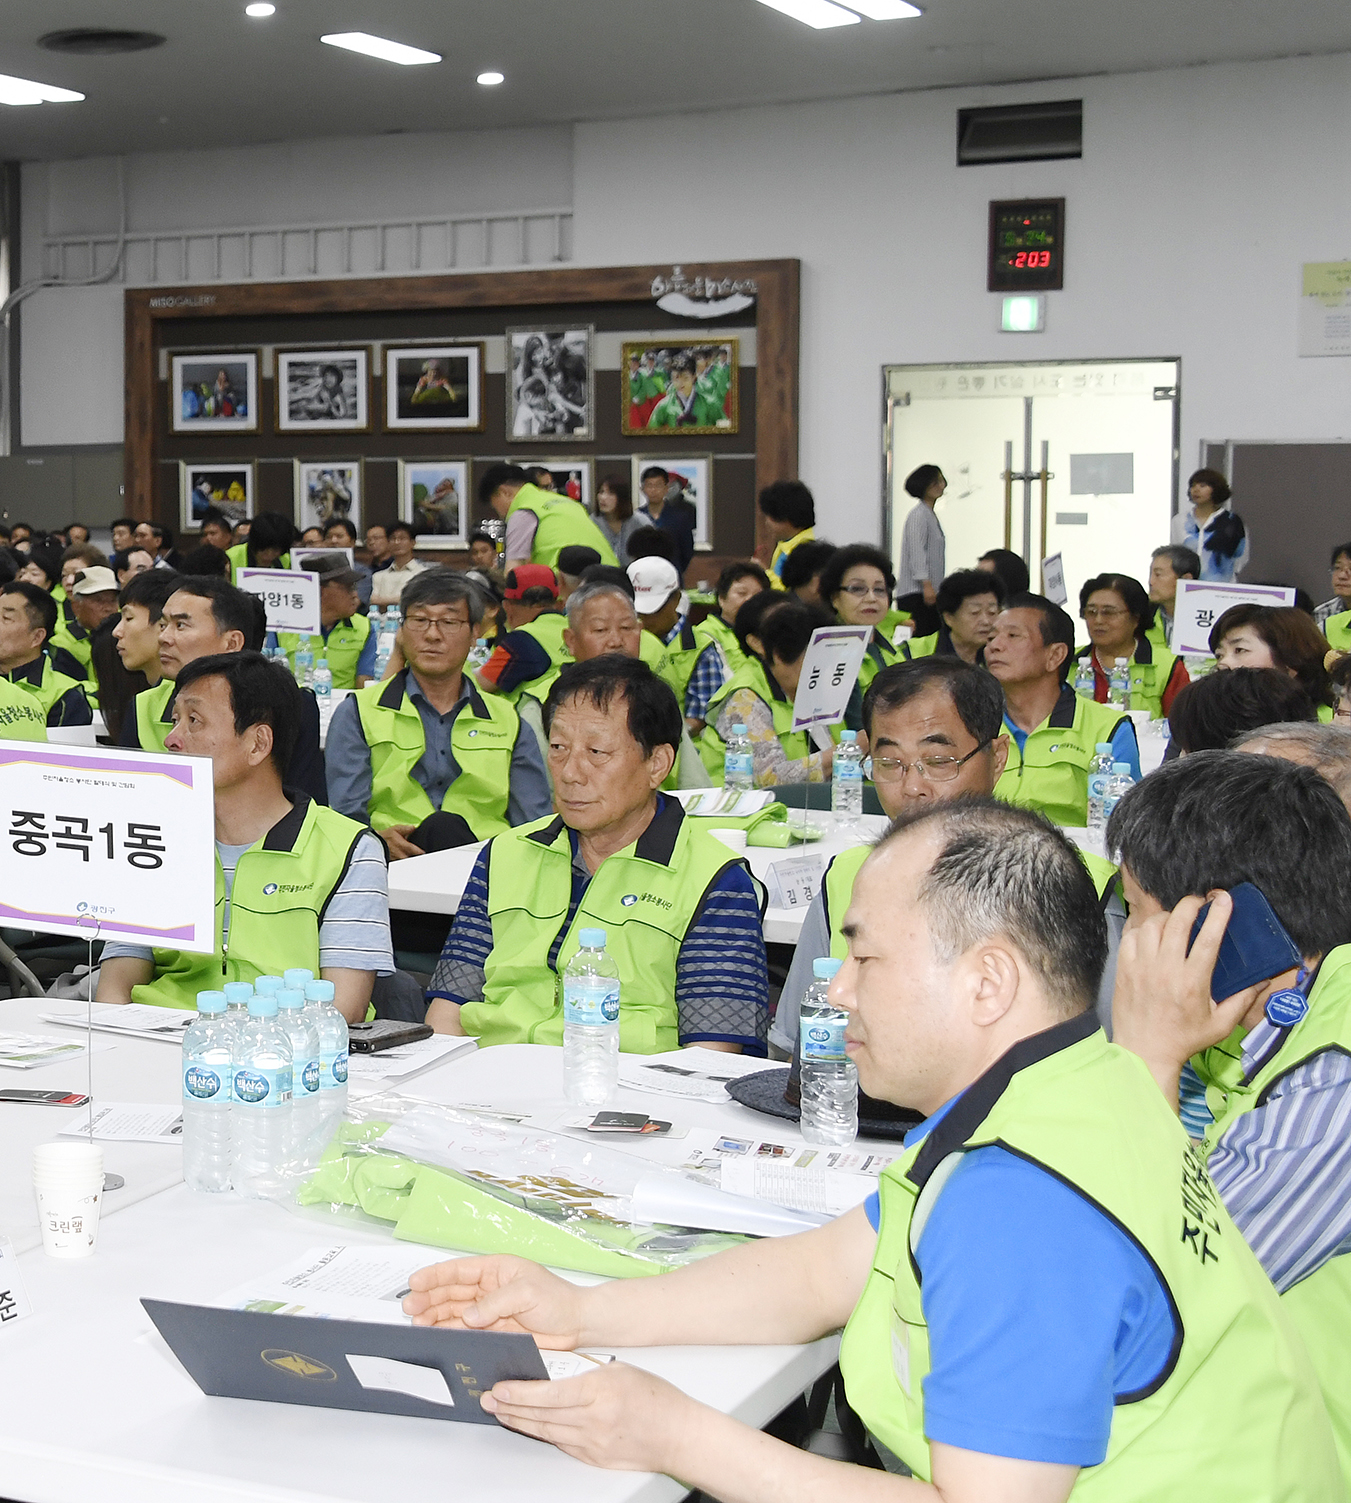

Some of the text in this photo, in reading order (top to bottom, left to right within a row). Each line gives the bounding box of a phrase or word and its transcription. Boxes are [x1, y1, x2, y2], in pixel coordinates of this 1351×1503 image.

[9, 810, 166, 870] 중곡1동
[187, 1074, 217, 1092] 백산수
[236, 1077, 265, 1092] 백산수
[48, 1215, 83, 1234] 크린랩
